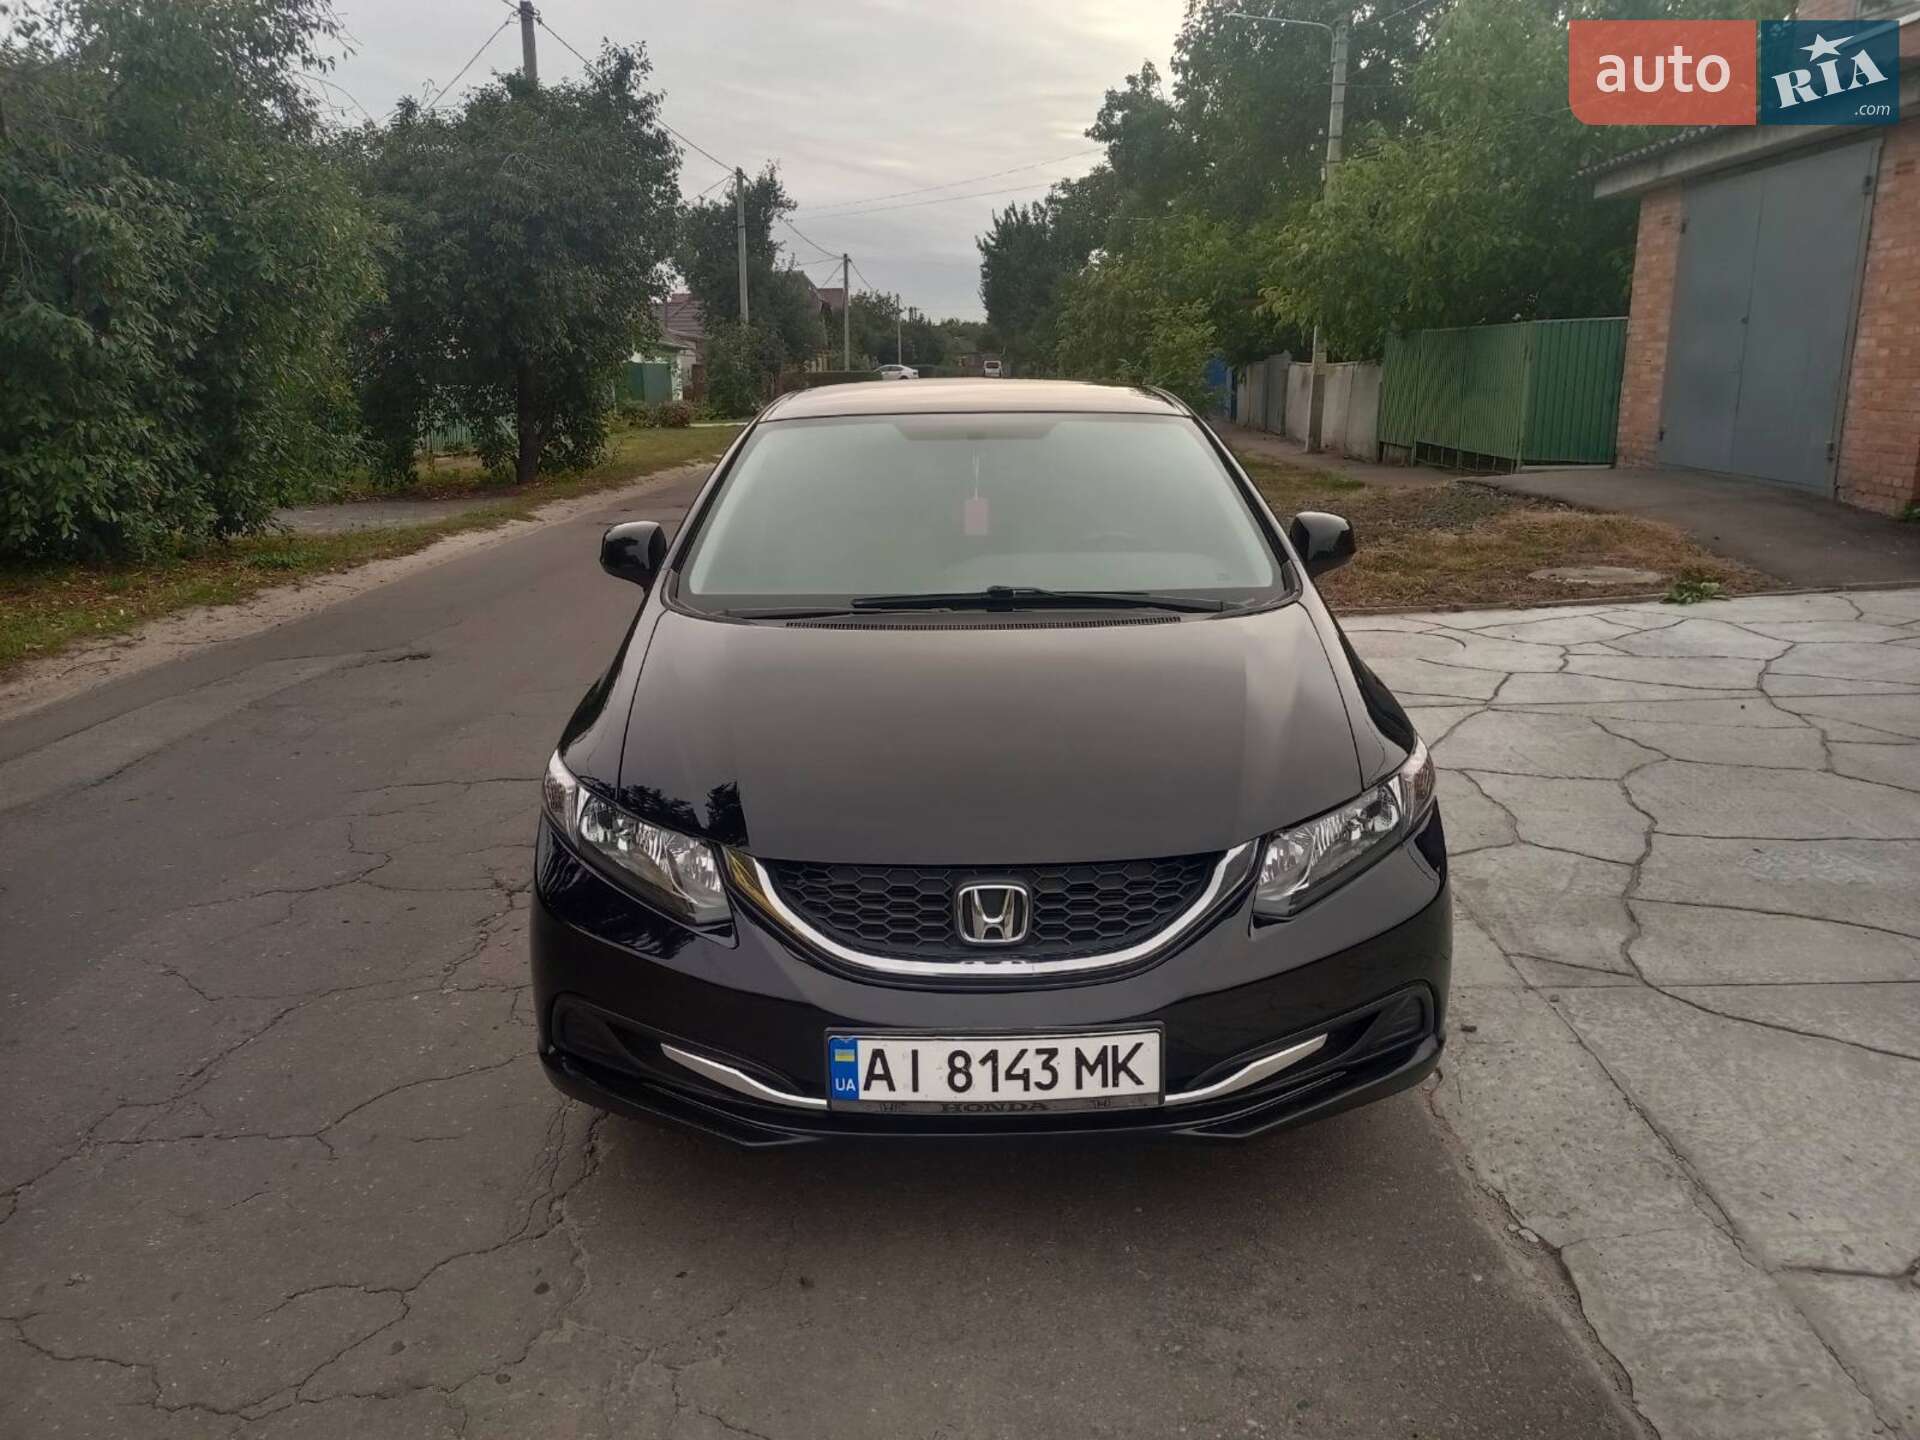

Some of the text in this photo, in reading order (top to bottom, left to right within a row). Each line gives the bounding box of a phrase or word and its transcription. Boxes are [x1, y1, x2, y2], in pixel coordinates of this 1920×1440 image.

[863, 1042, 1145, 1093] AI 8143 MK
[835, 1078, 856, 1092] UA
[940, 1101, 1048, 1113] HONDA
